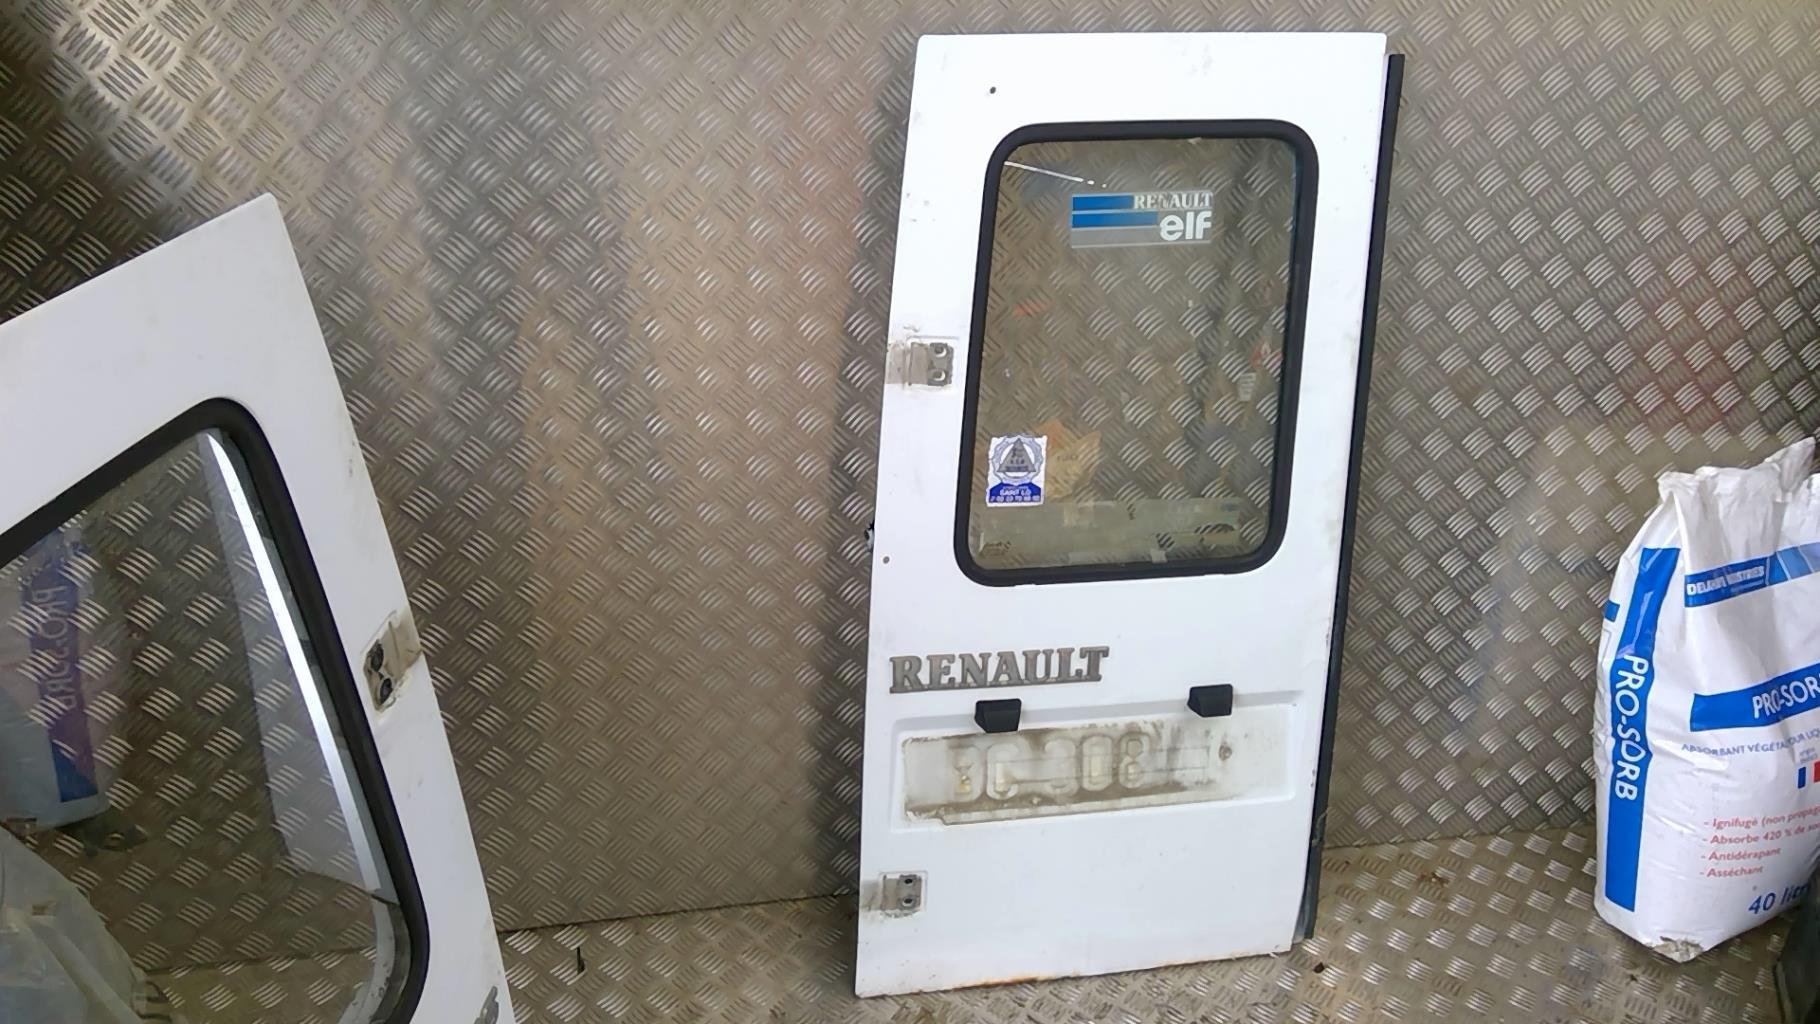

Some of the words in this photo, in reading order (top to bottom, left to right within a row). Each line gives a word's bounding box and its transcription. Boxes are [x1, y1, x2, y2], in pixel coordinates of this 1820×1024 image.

[1134, 192, 1213, 209] RENAULT
[1159, 211, 1213, 241] elf
[889, 645, 1110, 694] RENAULT
[1752, 672, 1820, 719] PRO-SOR
[1615, 655, 1650, 801] PRO-SORB
[1681, 743, 1745, 756] ABSORBANT
[1710, 834, 1759, 844] Absorbe
[1763, 830, 1782, 841] 420
[1708, 848, 1781, 861] Antidérapant
[1706, 866, 1763, 877] Asséchant
[1748, 892, 1776, 914] 40
[1780, 882, 1808, 905] litr
